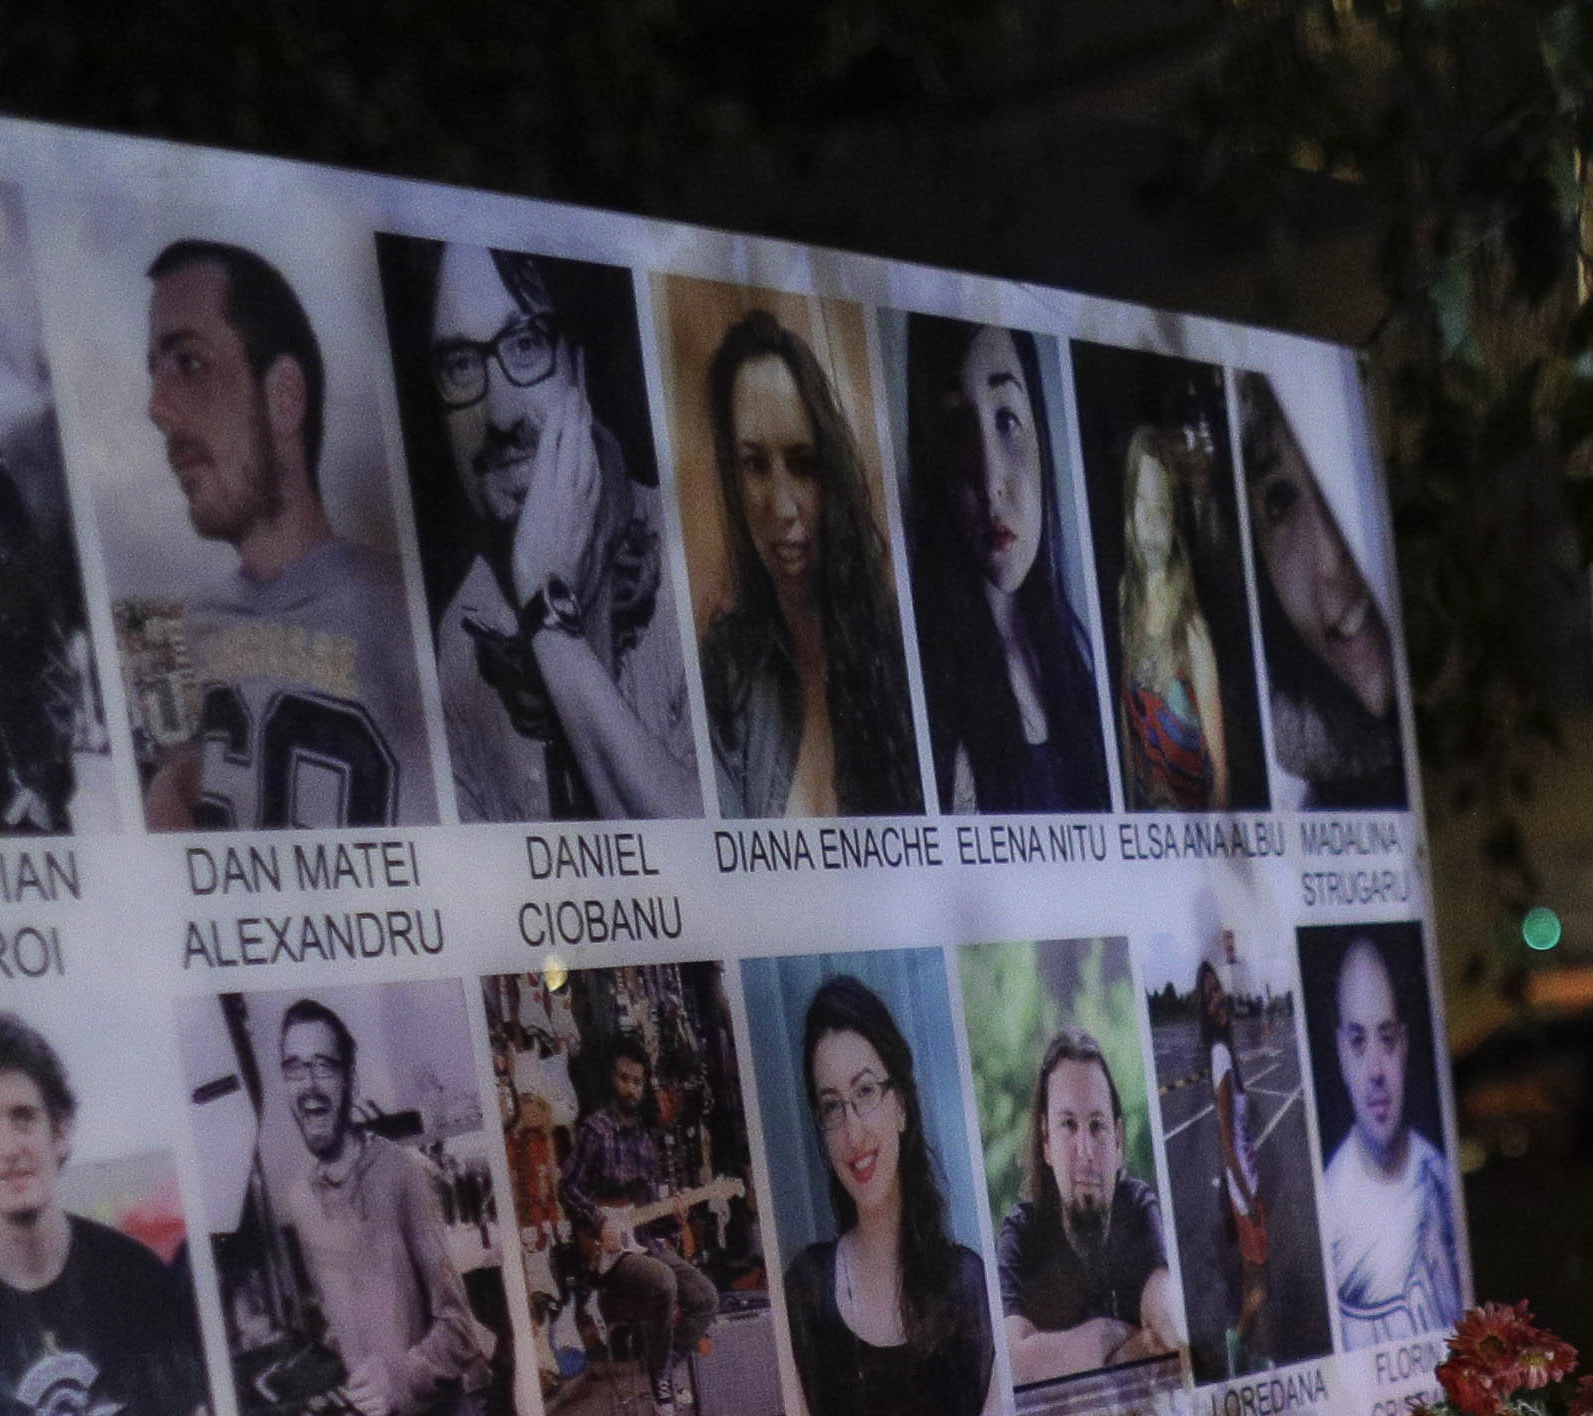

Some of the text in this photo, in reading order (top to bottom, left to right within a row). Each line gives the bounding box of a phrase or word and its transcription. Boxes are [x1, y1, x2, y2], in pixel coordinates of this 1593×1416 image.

[526, 831, 660, 881] DANIEL
[714, 824, 943, 874] DIANA ENACHE
[956, 822, 1108, 866] ELENA NITU
[1119, 820, 1286, 860] ELSA ANA ALBU
[1299, 821, 1403, 857] MADALINA
[186, 839, 421, 897] DAN MATEI
[1301, 869, 1411, 906] STRUGARU
[181, 907, 446, 971] ALEXANDRU
[517, 895, 683, 946] CIOBANU
